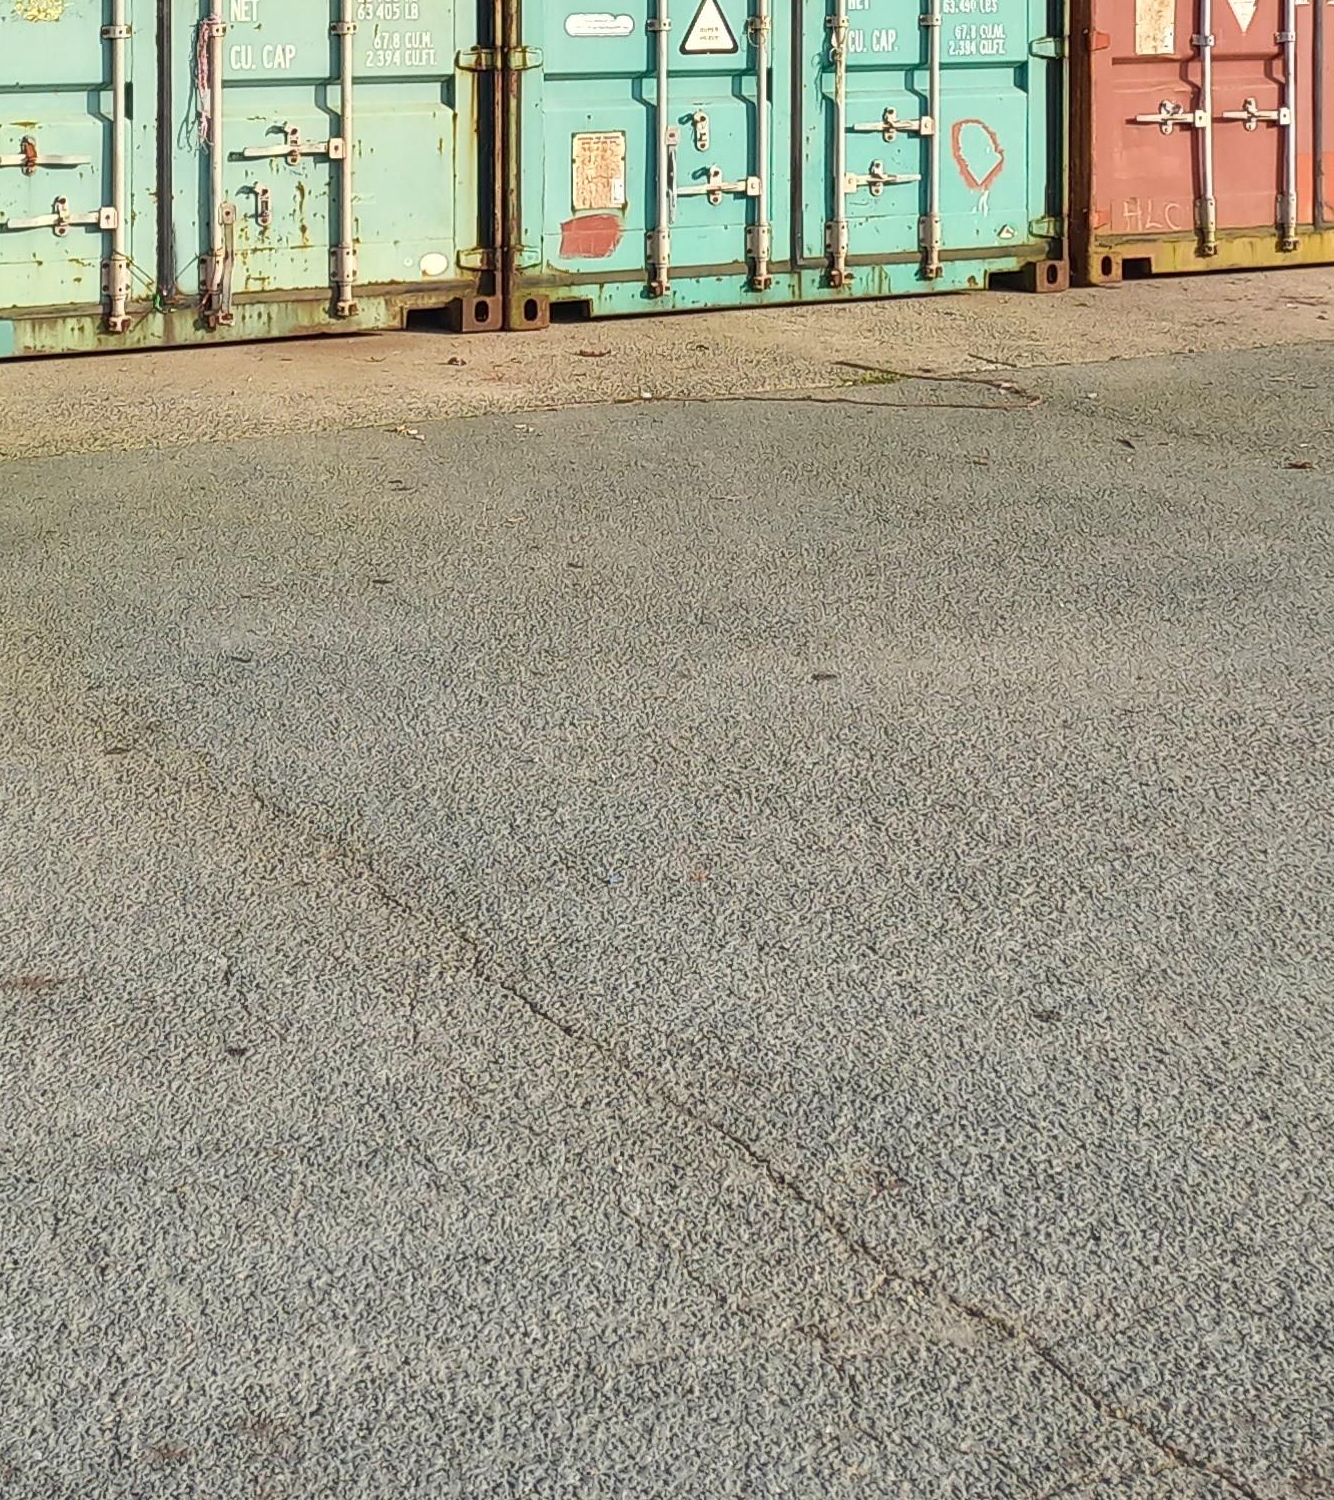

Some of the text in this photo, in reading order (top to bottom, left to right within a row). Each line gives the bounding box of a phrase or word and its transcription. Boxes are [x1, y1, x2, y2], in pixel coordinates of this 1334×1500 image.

[405, 4, 419, 20] LB
[848, 30, 866, 52] CU.
[873, 30, 898, 52] CAP.
[230, 45, 257, 70] CU.
[263, 44, 296, 69] CAP
